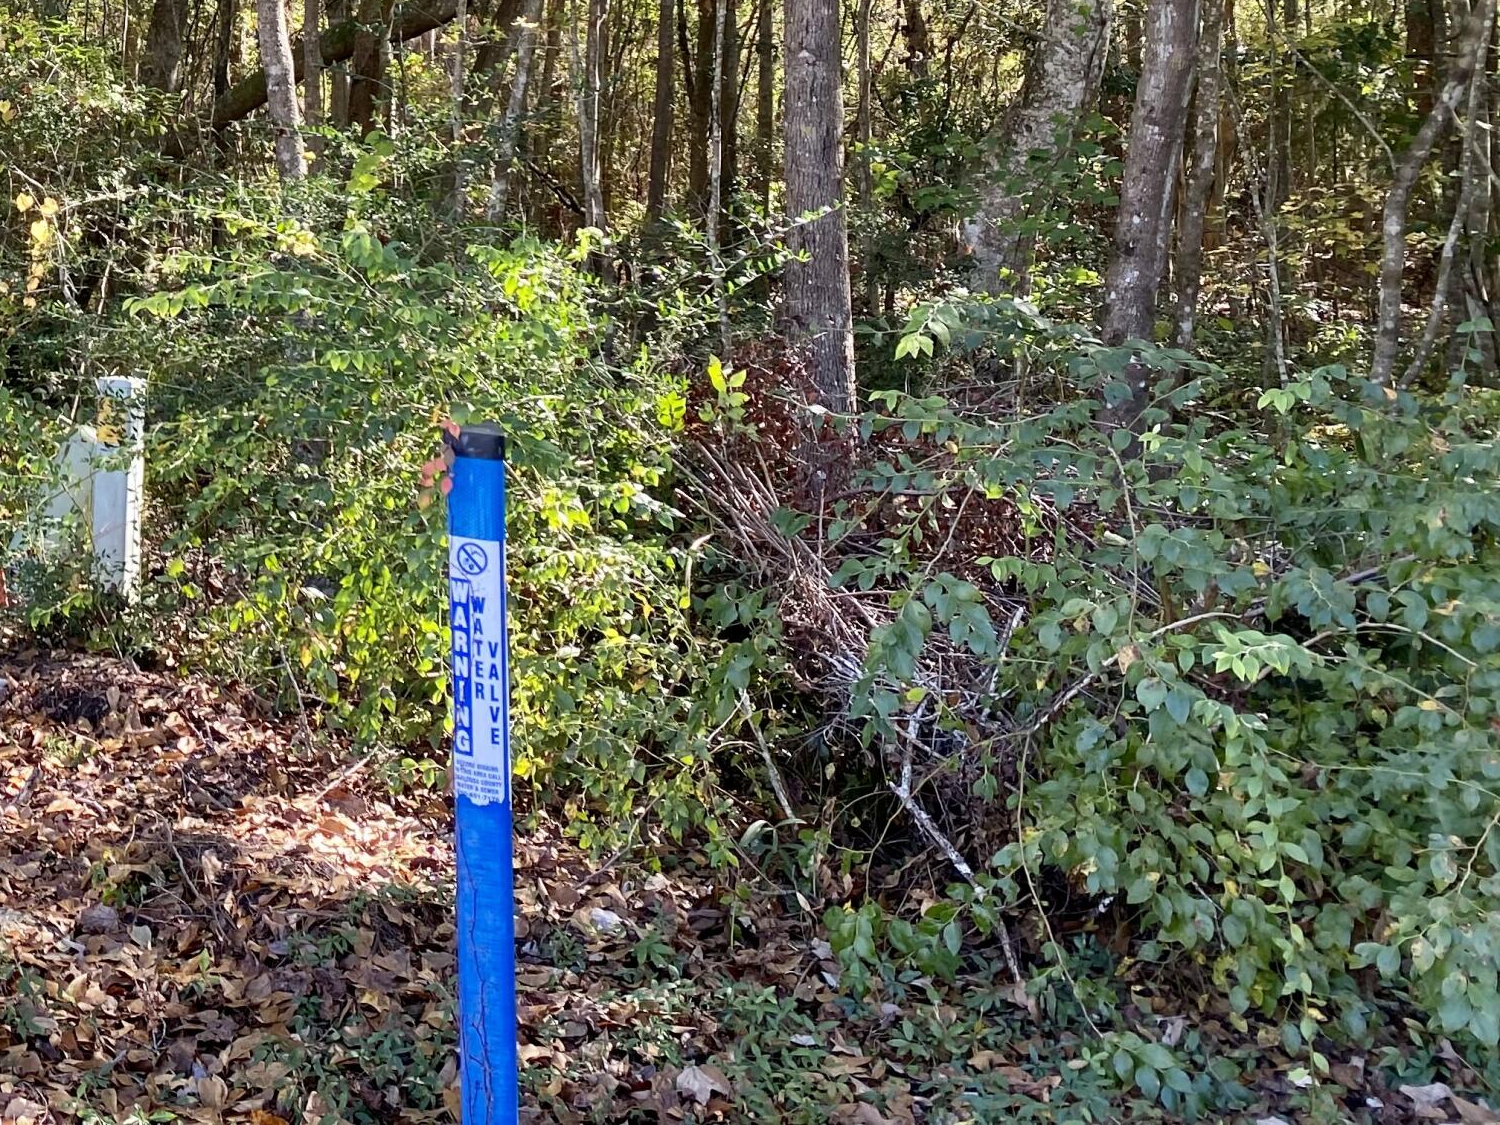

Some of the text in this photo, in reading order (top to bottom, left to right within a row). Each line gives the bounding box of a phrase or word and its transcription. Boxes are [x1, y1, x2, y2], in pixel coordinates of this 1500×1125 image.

[452, 580, 472, 753] WARNING
[471, 596, 500, 745] WATER VALVE
